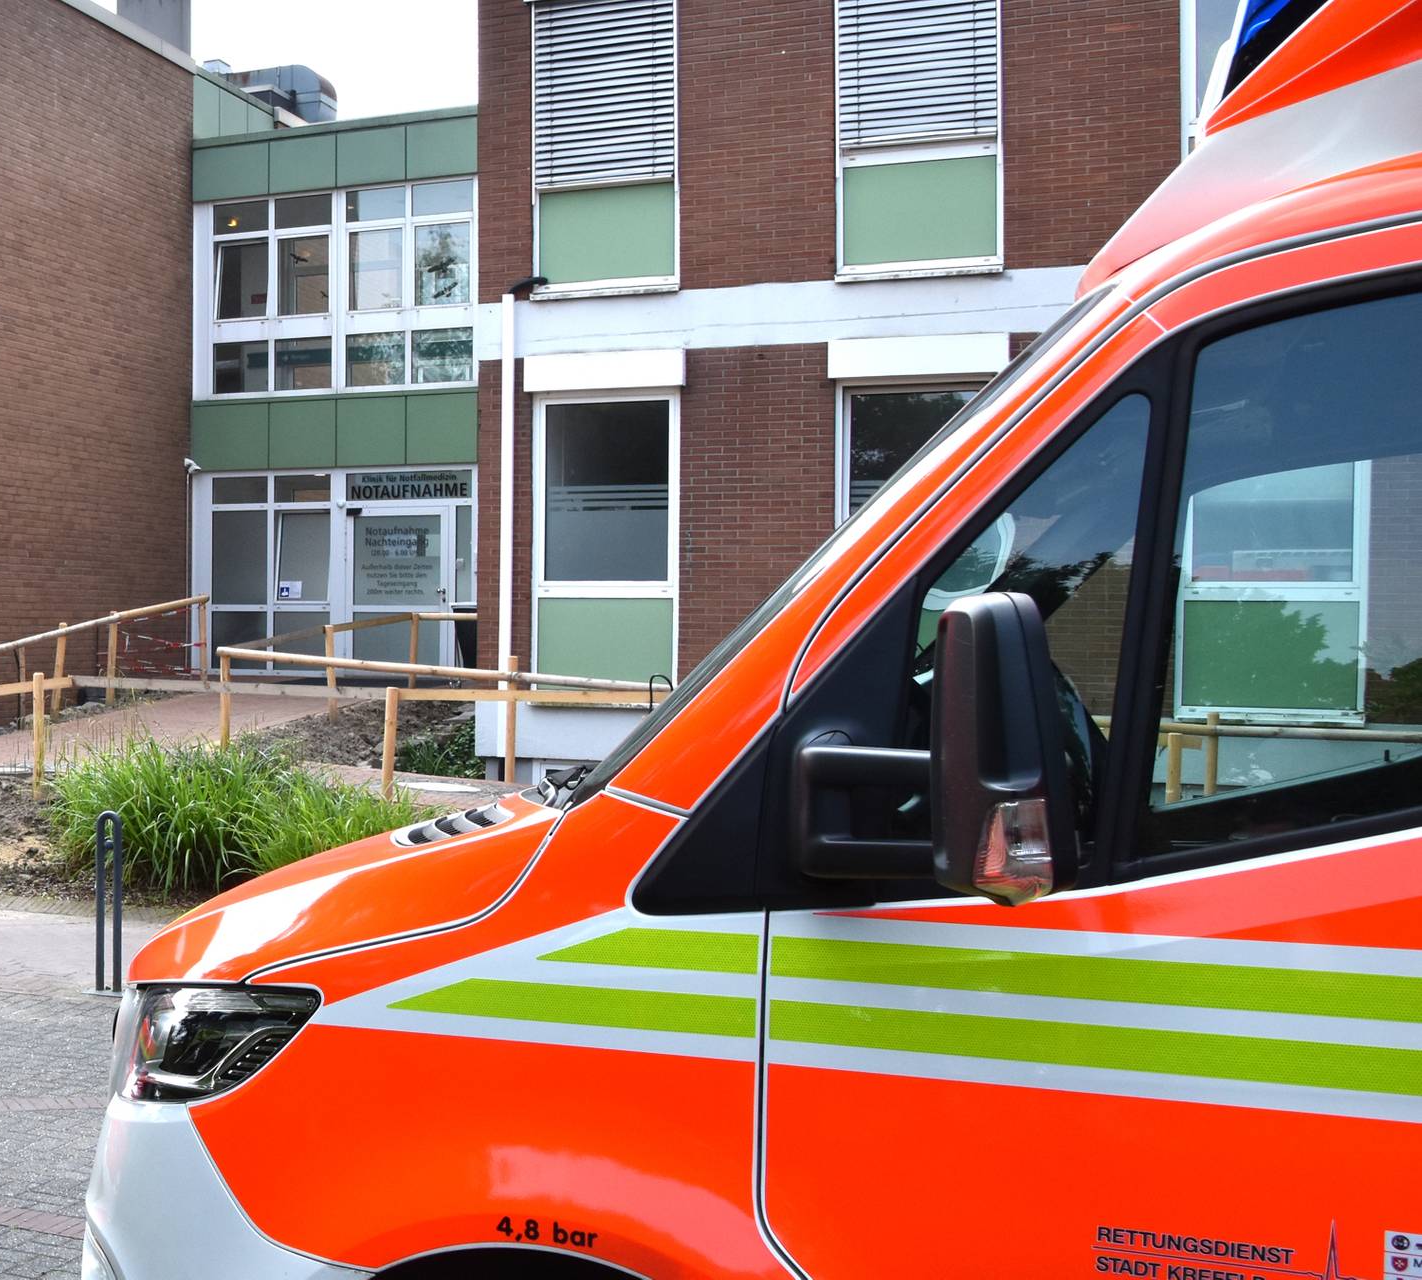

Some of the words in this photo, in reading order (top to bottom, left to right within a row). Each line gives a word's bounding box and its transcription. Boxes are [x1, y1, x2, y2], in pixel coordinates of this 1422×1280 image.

[362, 474, 382, 483] Klinik
[386, 474, 397, 482] für
[399, 472, 457, 482] Notfallmedizin
[351, 482, 467, 499] NOTAUFNAHME
[365, 526, 430, 536] Notaufnahme
[365, 538, 429, 548] Nachteingag
[496, 1216, 540, 1242] 4,8
[553, 1221, 598, 1248] bar
[1096, 1226, 1294, 1265] RETTUNGSDIENST
[1095, 1256, 1160, 1279] STADT
